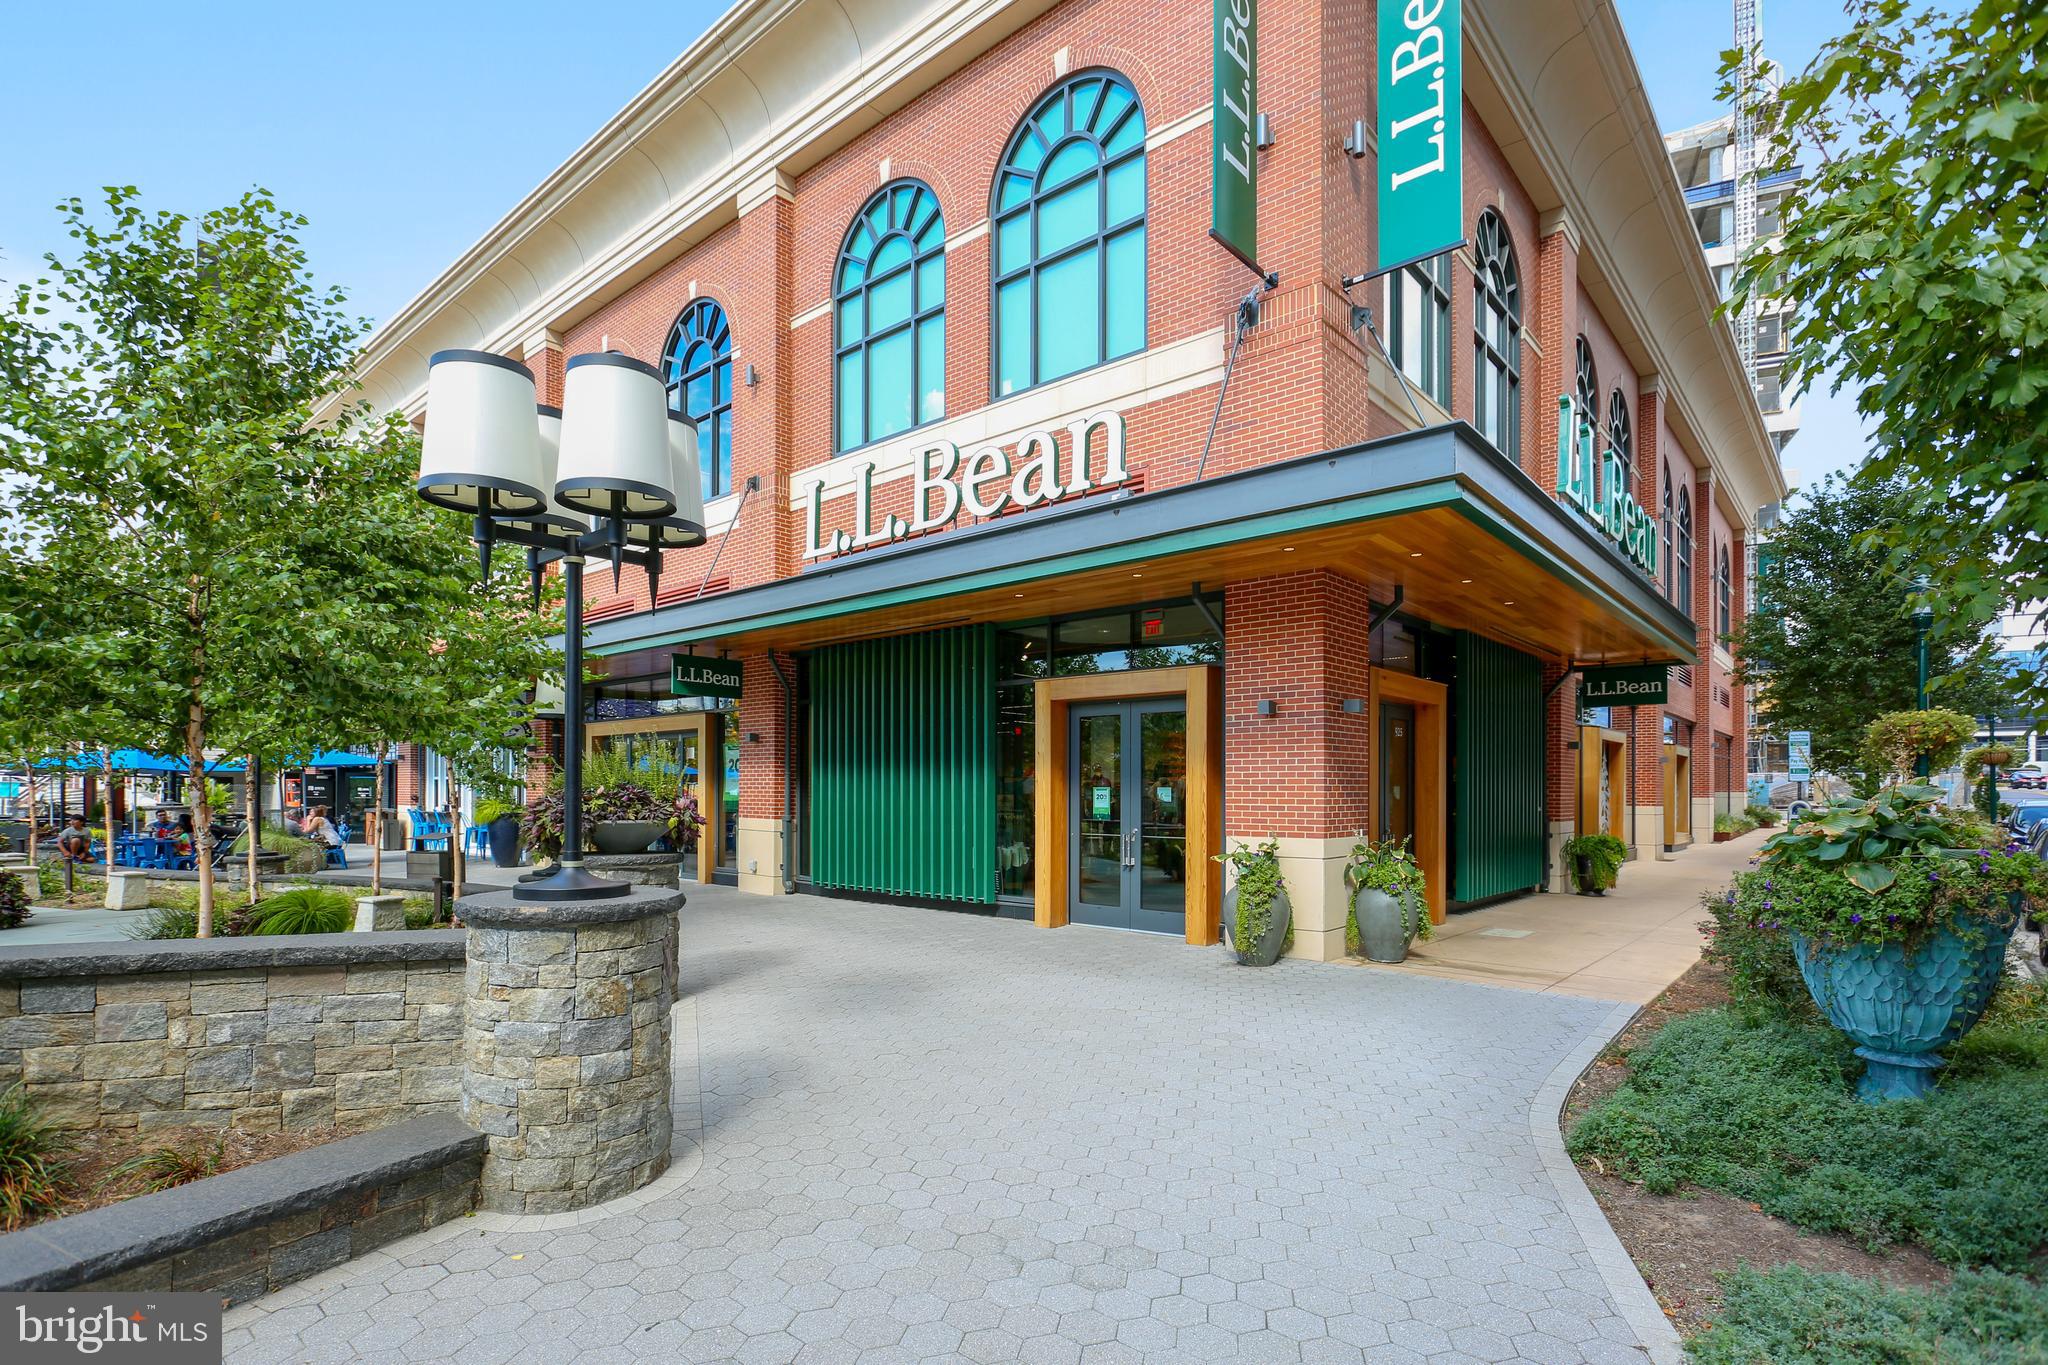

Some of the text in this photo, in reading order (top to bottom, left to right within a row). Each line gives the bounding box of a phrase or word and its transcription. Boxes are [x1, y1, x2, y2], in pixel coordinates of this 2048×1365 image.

[802, 409, 1131, 561] L.L.Bean
[1556, 394, 1658, 577] L.L.Bean
[676, 666, 740, 687] L.L.Bean
[1586, 680, 1663, 696] L.L.Bean
